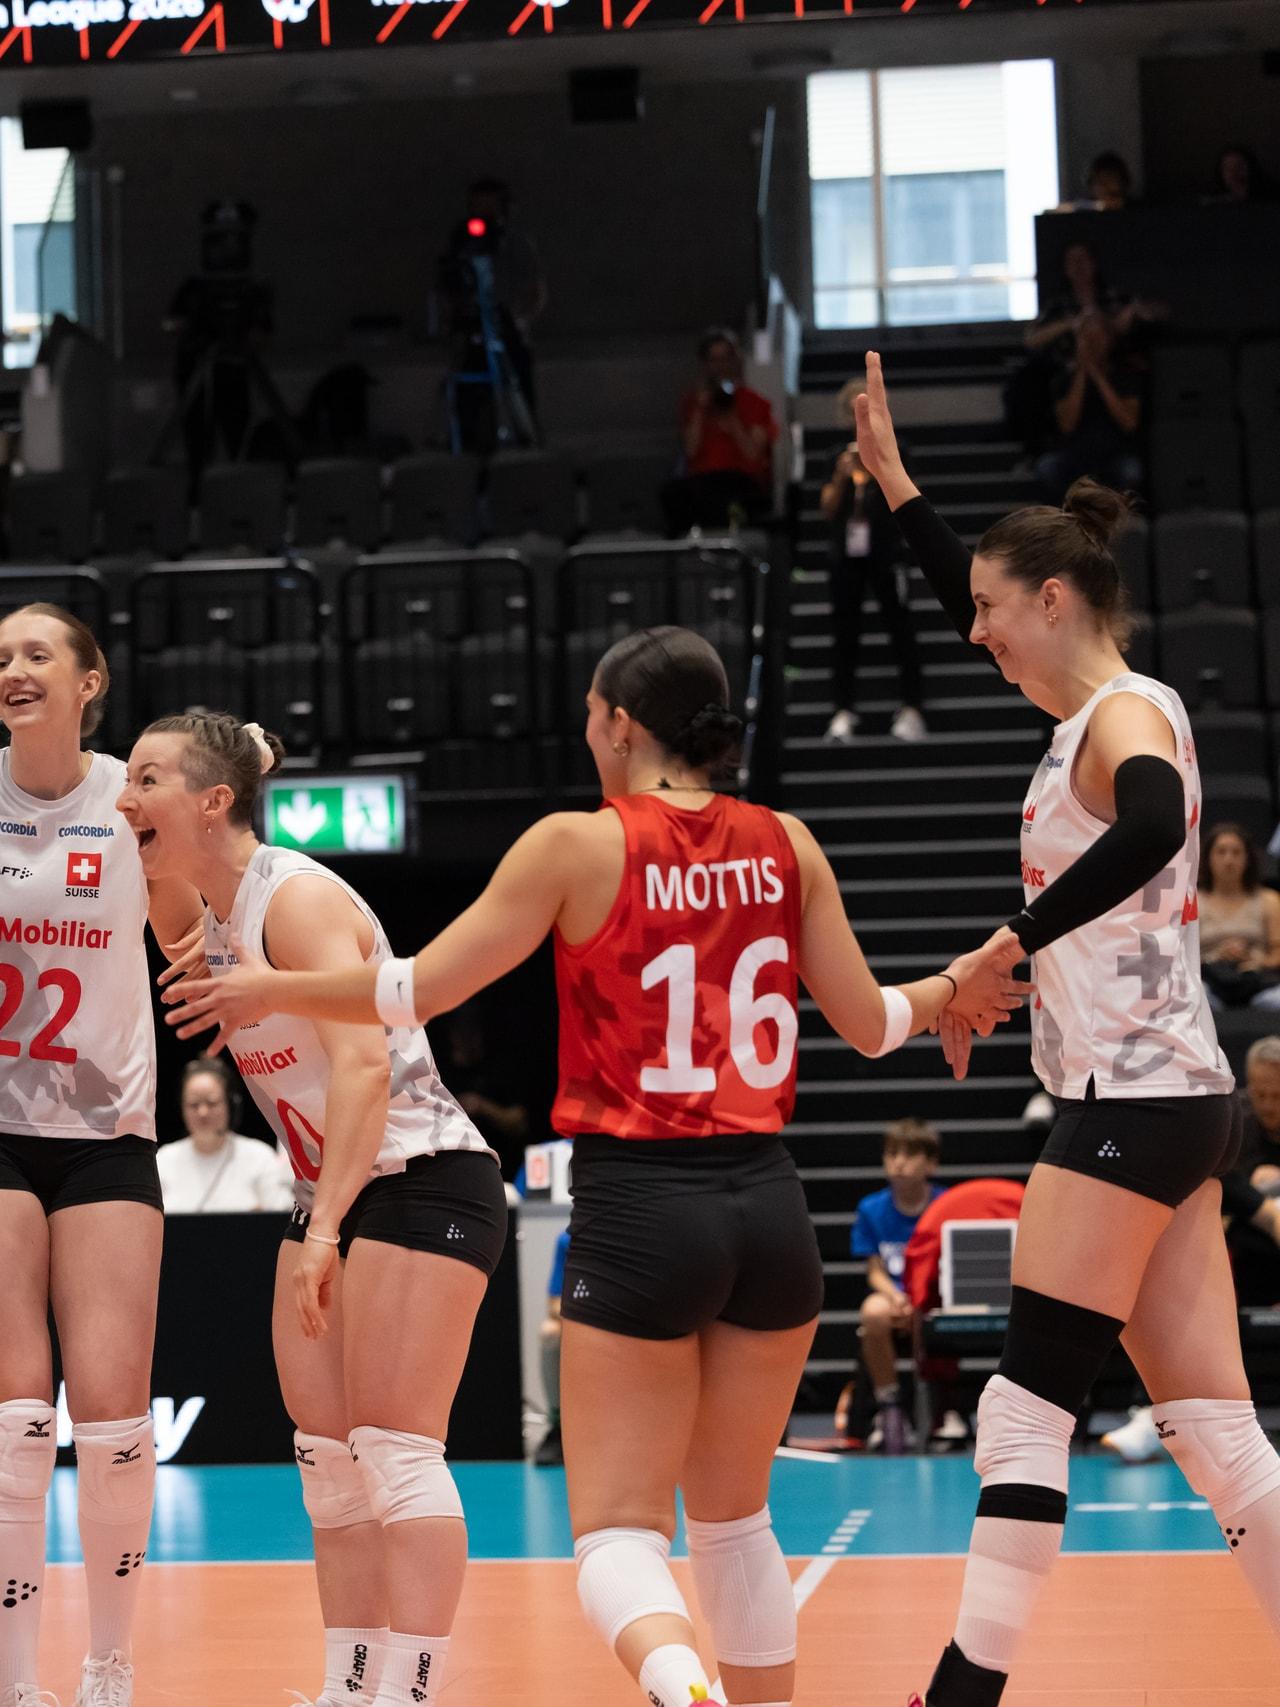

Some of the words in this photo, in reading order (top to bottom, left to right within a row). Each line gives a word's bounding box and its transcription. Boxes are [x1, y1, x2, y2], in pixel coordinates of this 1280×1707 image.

[12, 0, 125, 31] League
[58, 823, 115, 838] CONCORDIA
[65, 887, 100, 899] SUISSE
[645, 856, 785, 911] MOTTIS
[640, 935, 799, 1093] 16
[352, 1644, 367, 1680] CRAFT
[416, 1652, 431, 1688] CRAFT
